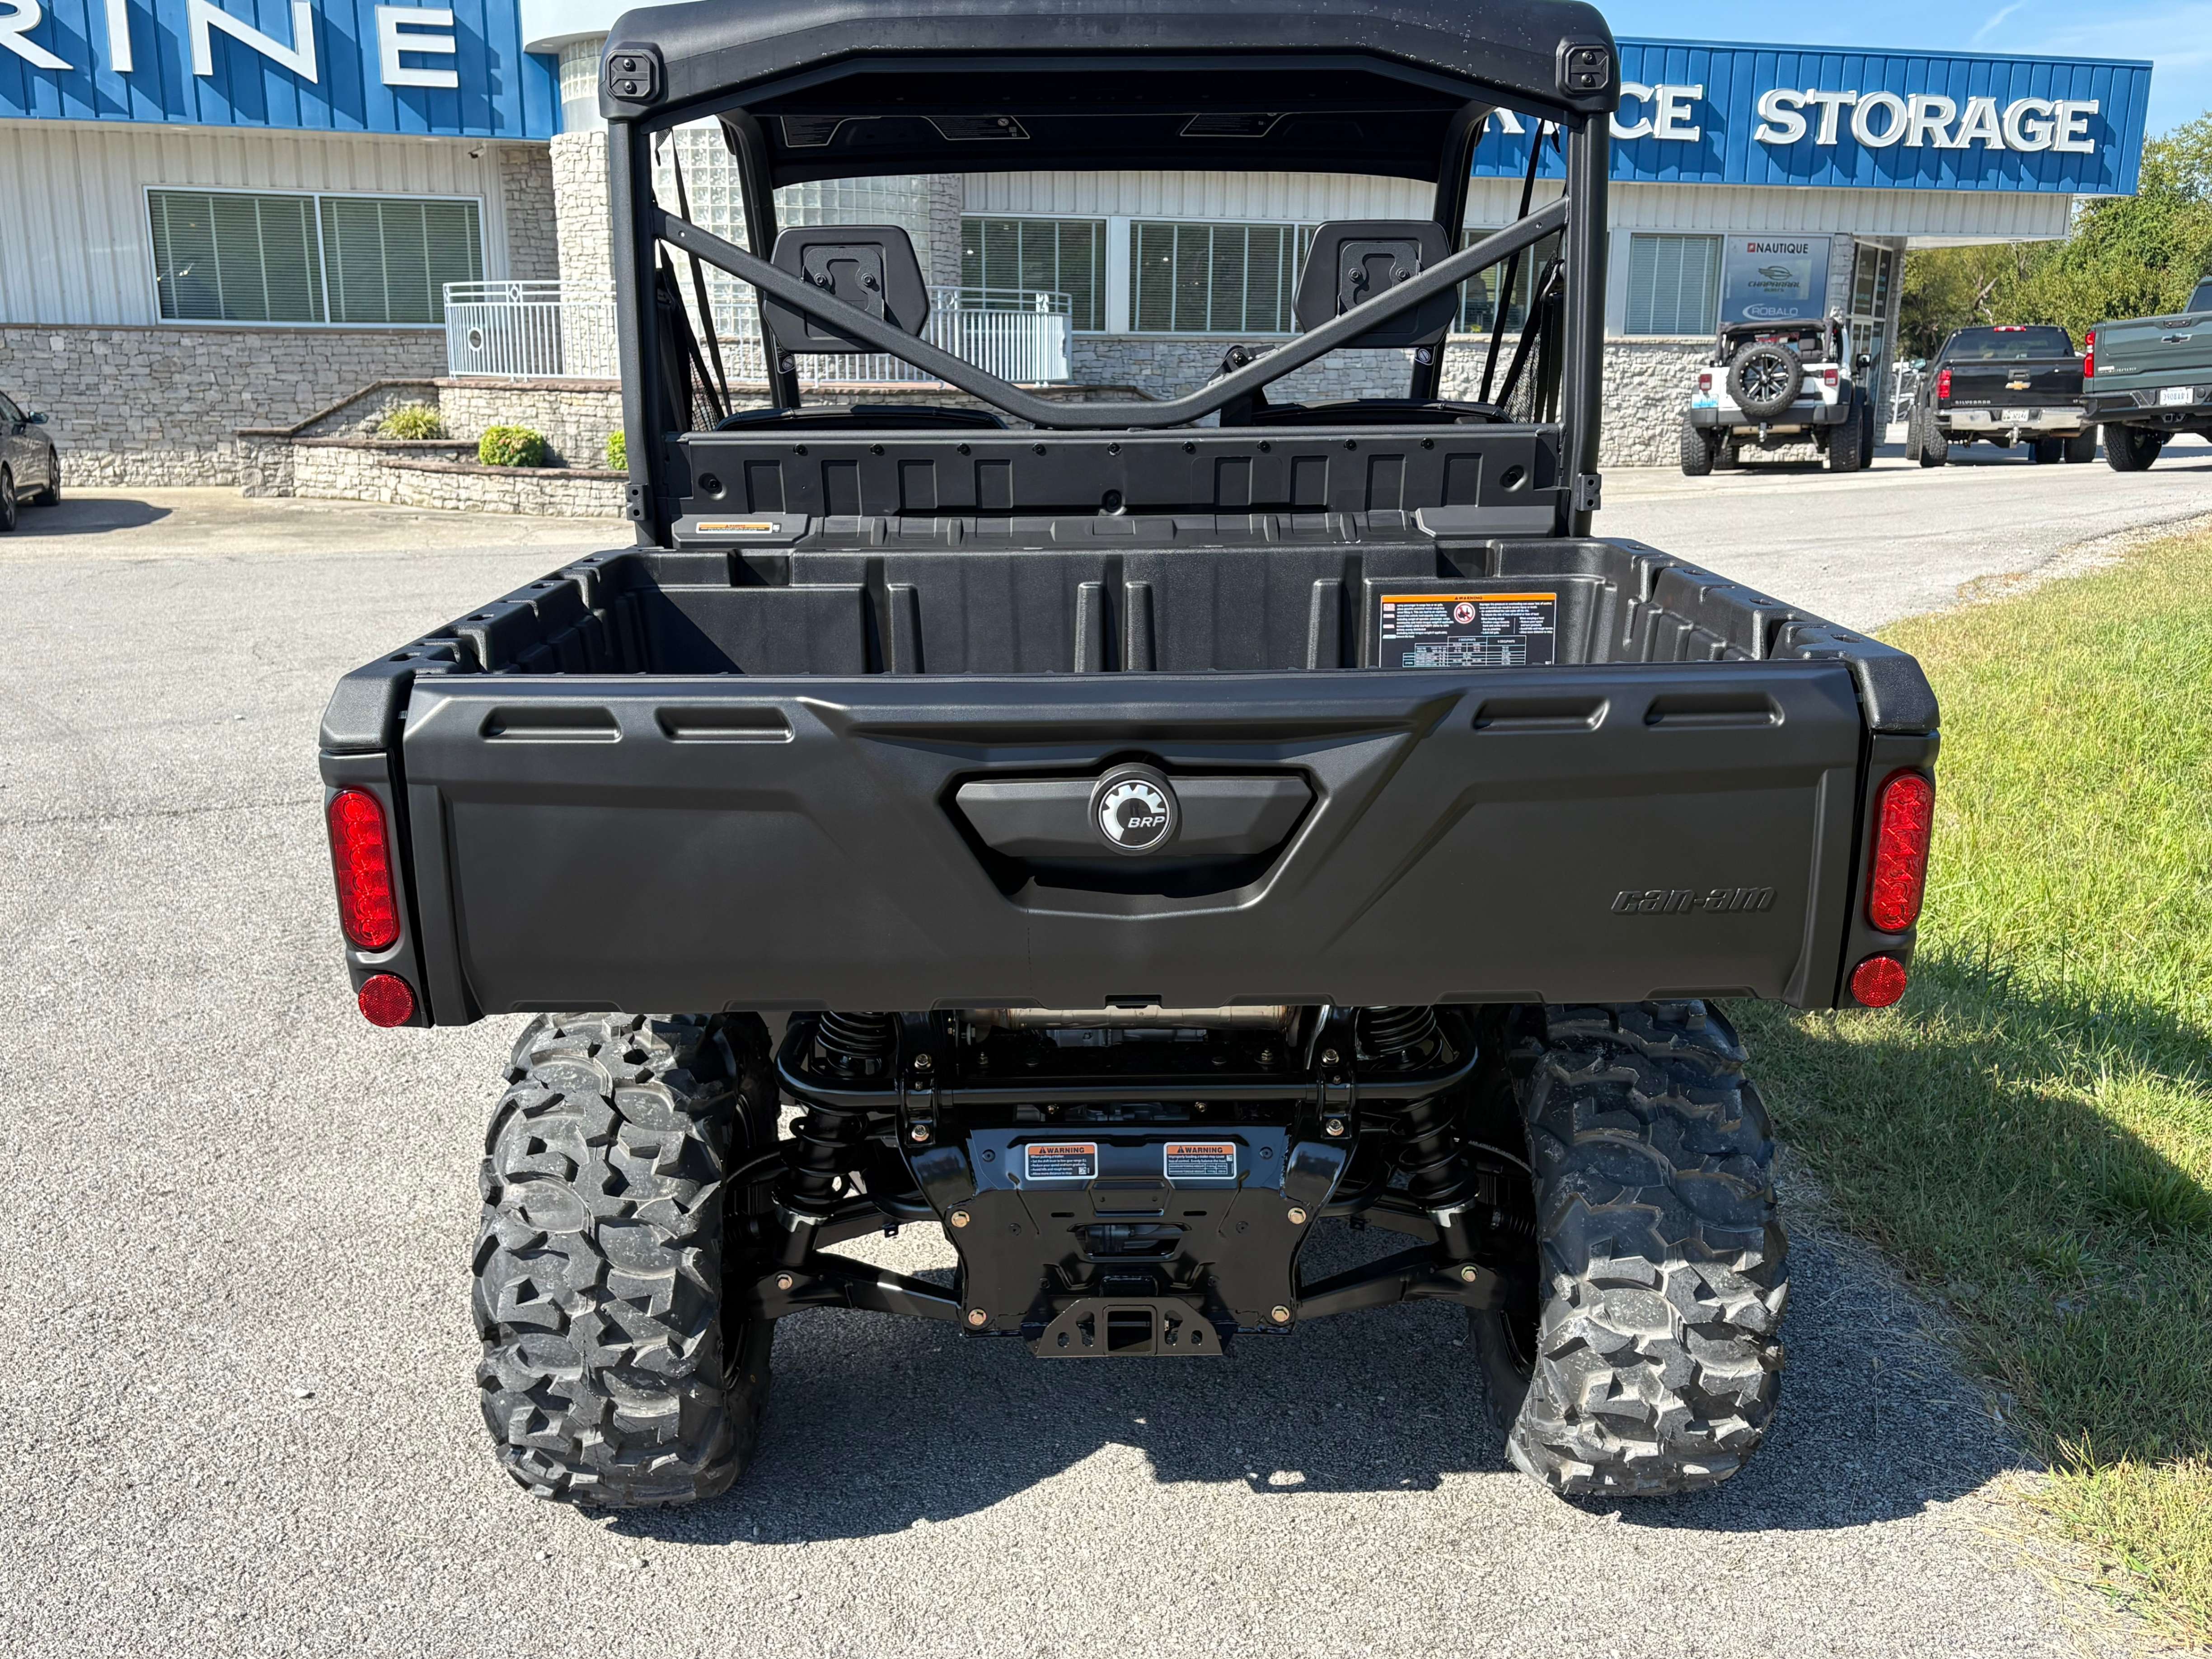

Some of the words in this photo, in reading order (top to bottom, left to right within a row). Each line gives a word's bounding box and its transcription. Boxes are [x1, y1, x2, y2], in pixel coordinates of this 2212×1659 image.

[1753, 88, 2099, 154] STORAGE
[1756, 243, 1809, 254] NAUTIQUE
[1751, 307, 1799, 316] ROBALO
[1128, 816, 1165, 828] BRP
